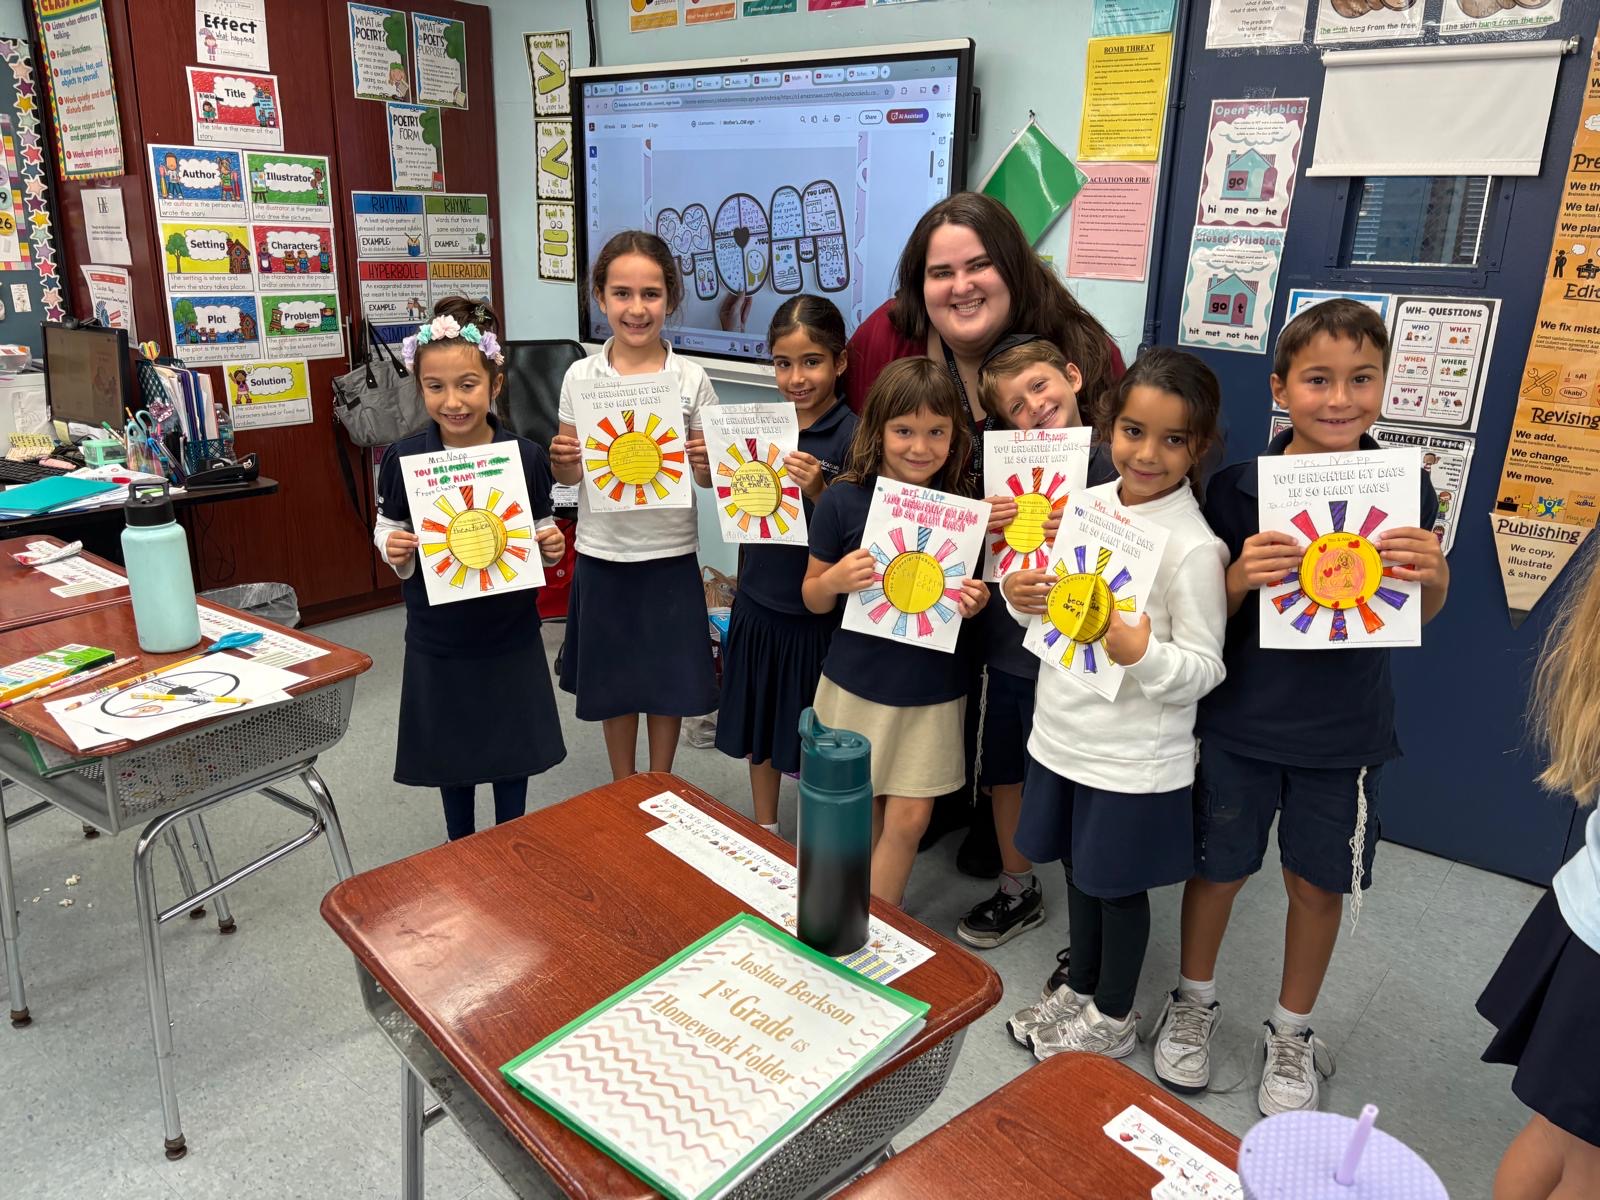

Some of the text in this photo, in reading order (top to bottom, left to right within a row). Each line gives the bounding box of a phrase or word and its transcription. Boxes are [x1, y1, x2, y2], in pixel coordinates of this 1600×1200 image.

[204, 13, 257, 34] Effect
[355, 14, 374, 28] WHAT
[1520, 16, 1533, 24] the
[355, 26, 387, 42] POETRY?
[418, 20, 436, 35] WHAT
[534, 39, 566, 49] Greater Than
[1104, 44, 1155, 54] BOMB THREAT
[418, 44, 447, 58] PURPOSE?
[224, 88, 246, 98] Title
[864, 113, 877, 121] Share
[904, 111, 924, 120] Assistant
[1215, 104, 1304, 117] Open Syllables
[393, 113, 419, 128] POETRY
[399, 127, 420, 142] FORM
[182, 169, 217, 179] Author
[266, 171, 312, 183] Illustrator
[1228, 178, 1244, 188] go
[1570, 181, 1587, 191] We
[371, 196, 409, 213] RHYTHM
[444, 198, 472, 212] RHYME
[1207, 205, 1216, 213] hi
[1265, 207, 1277, 215] he
[1565, 202, 1582, 212] We
[1561, 223, 1578, 233] We
[191, 240, 227, 251] Setting
[271, 241, 318, 250] Characters
[1195, 233, 1281, 246] Closed Syllables
[368, 263, 420, 279] HYPERBOLE
[431, 263, 489, 279] ALLITERATION
[1212, 302, 1243, 313] go t
[1429, 307, 1483, 317] QUESTIONS
[207, 315, 227, 324] Plot
[284, 312, 320, 321] Problem
[1540, 320, 1557, 330] We
[1559, 322, 1571, 332] fix
[1441, 358, 1467, 366] WHERE
[250, 377, 287, 387] Solution
[580, 384, 671, 400] YOU BRIGHTEN MY DAYS
[592, 395, 661, 410] IN SO MANY WAYS!
[1531, 407, 1600, 429] Revising
[1378, 432, 1465, 450] CHARACTER TRAITS
[1515, 430, 1556, 442] We add.
[1511, 448, 1570, 463] We change.
[414, 468, 431, 477] YOU
[1273, 467, 1405, 485] YOU BRIGHTEN MY DAYS
[1506, 470, 1554, 485] We move.
[427, 478, 438, 487] IN
[1288, 482, 1390, 498] IN SO MANY WAYS!
[1074, 506, 1088, 519] YOU
[1088, 513, 1125, 537] BRIGHTEN
[1136, 536, 1154, 551] DAYS
[1497, 518, 1581, 544] Publishing
[1511, 543, 1555, 558] We copy,
[1508, 556, 1553, 570] illustrate
[1508, 569, 1547, 581] & share
[731, 951, 857, 1027] Joshua Berkson
[699, 979, 740, 1000] 1st
[729, 994, 795, 1042] Grade
[650, 993, 797, 1086] Homework Folder
[1132, 1122, 1146, 1135] Aa
